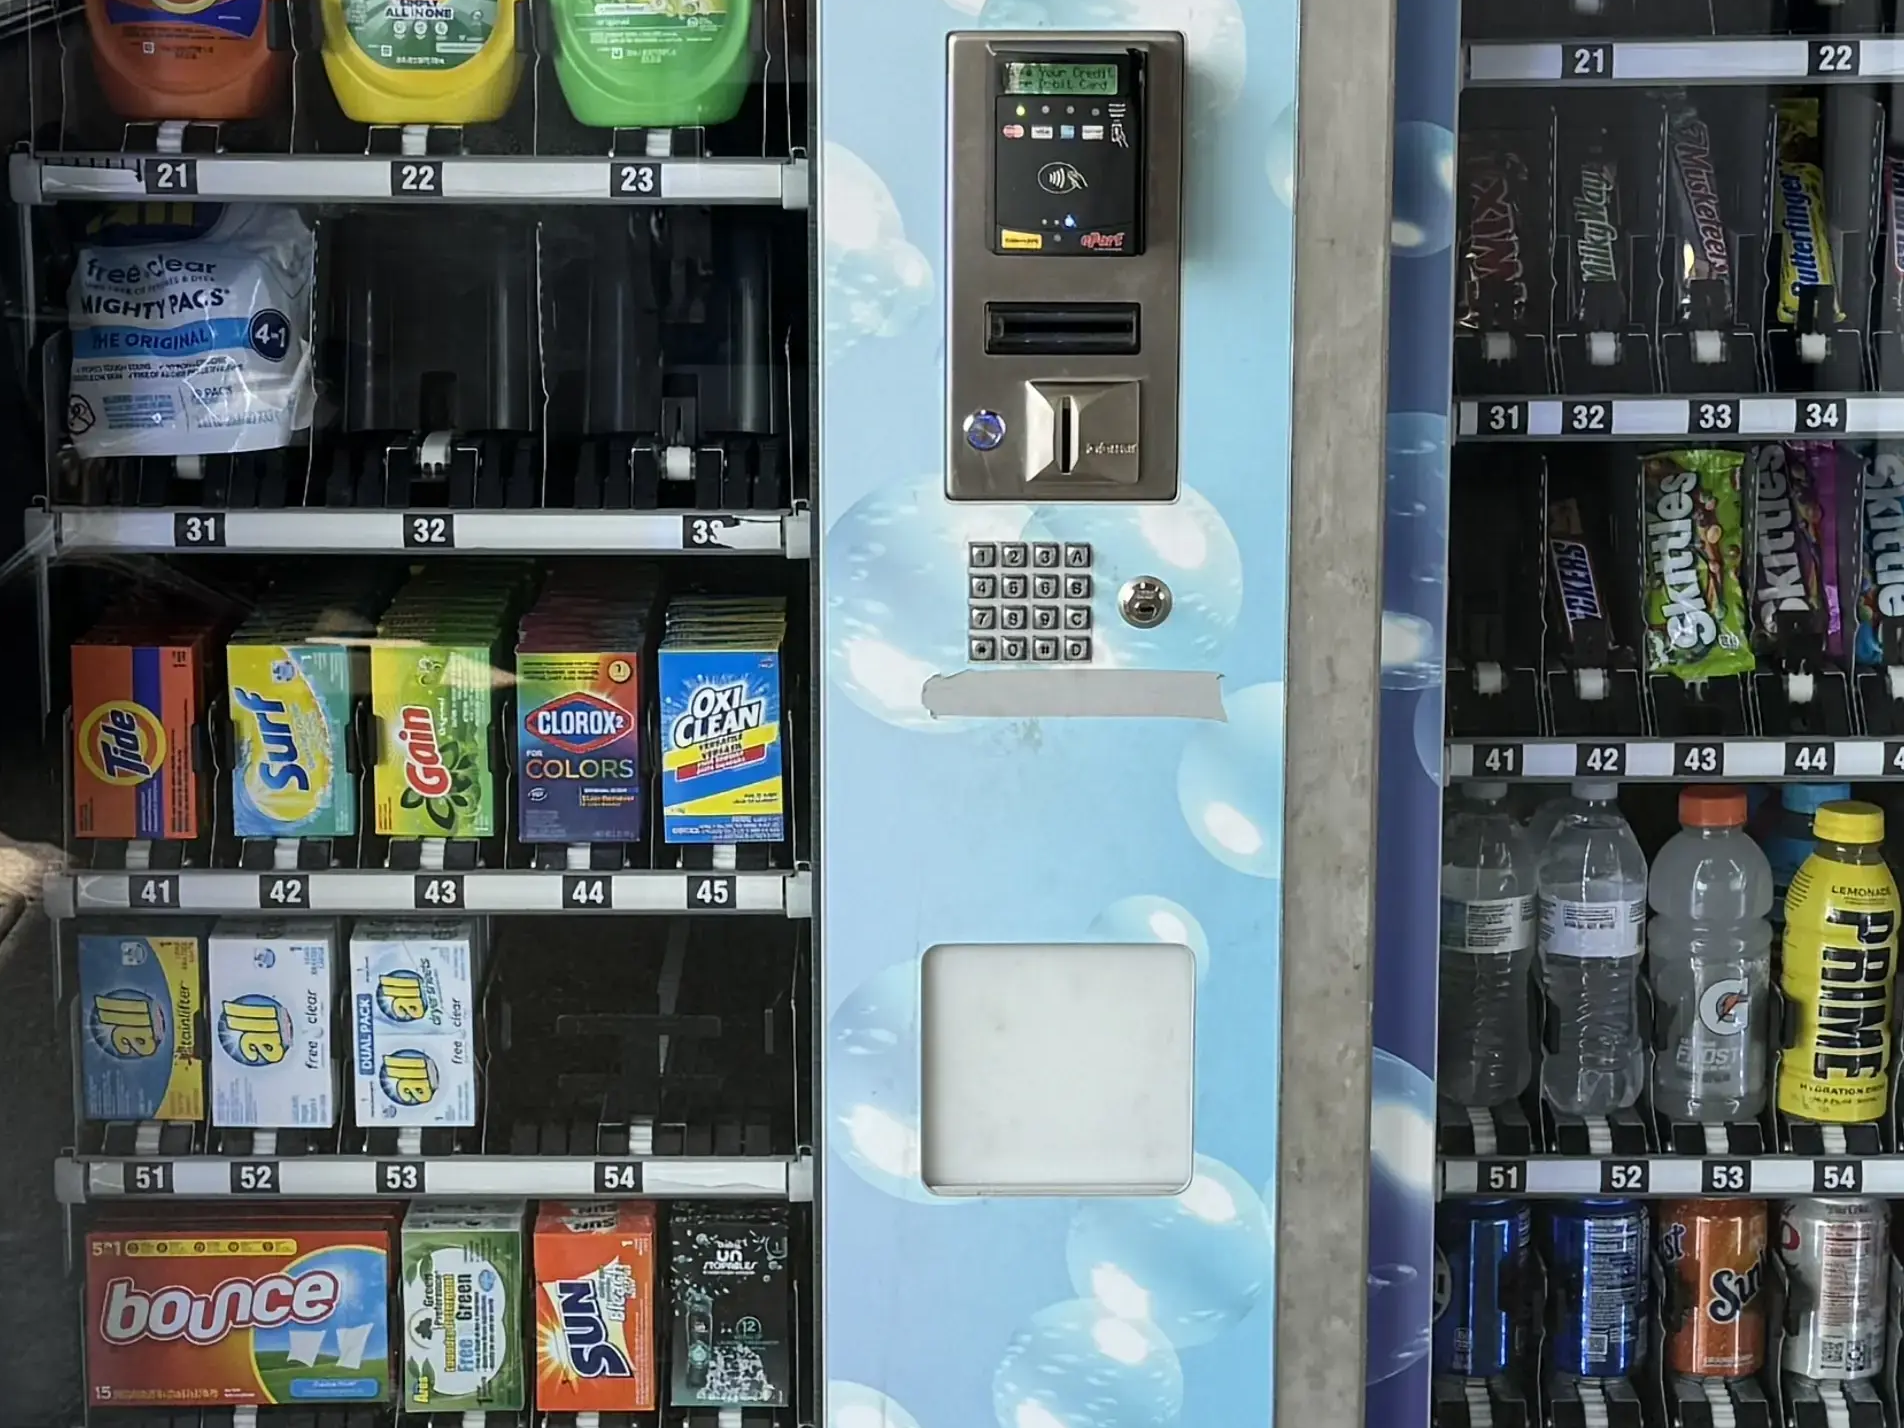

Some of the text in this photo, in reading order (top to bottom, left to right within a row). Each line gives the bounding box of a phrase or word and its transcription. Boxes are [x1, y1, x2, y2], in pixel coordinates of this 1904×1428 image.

[1574, 48, 1604, 74] 21
[1818, 44, 1853, 71] 22
[157, 162, 654, 192] 21 22 23
[86, 258, 141, 285] free
[145, 253, 217, 278] clear
[80, 294, 166, 320] MIGHTY
[124, 327, 209, 351] ORIGINAL
[1490, 404, 1519, 430] 31
[1572, 404, 1605, 430] 32
[1699, 403, 1732, 429] 33
[1806, 403, 1839, 428] 34
[186, 517, 446, 543] 31 32
[1647, 471, 1716, 648] Skittles
[691, 684, 744, 720] OXI
[673, 700, 762, 749] CLEAN
[100, 707, 154, 780] Tide
[399, 706, 451, 797] Gain
[525, 749, 544, 758] FOR
[1485, 747, 1514, 771] 41
[1586, 747, 1619, 771] 42
[1684, 747, 1717, 771] 43
[1794, 746, 1828, 771] 44
[525, 758, 635, 780] COLORS
[141, 879, 729, 904] 41 42 43 44 45
[1831, 884, 1892, 898] LEMONADE
[378, 973, 425, 1021] all
[1814, 909, 1896, 1080] PRIME
[93, 993, 158, 1057] all
[221, 998, 286, 1064] all
[302, 988, 321, 1070] free clear
[359, 998, 373, 1070] DUAL PACK
[448, 997, 464, 1065] free clear
[1676, 1046, 1741, 1067] FROST
[382, 1054, 434, 1104] all
[135, 1165, 635, 1189] 51 52 53 54
[1490, 1166, 1518, 1189] 51
[1611, 1165, 1642, 1189] 52
[1712, 1165, 1744, 1189] 53
[1824, 1165, 1856, 1189] 54
[105, 1270, 336, 1341] bounce
[423, 1273, 435, 1308] Green
[455, 1273, 475, 1373] Free Green
[556, 1279, 633, 1378] SUN
[742, 1320, 757, 1333] 12
[95, 1386, 112, 1401] 15
